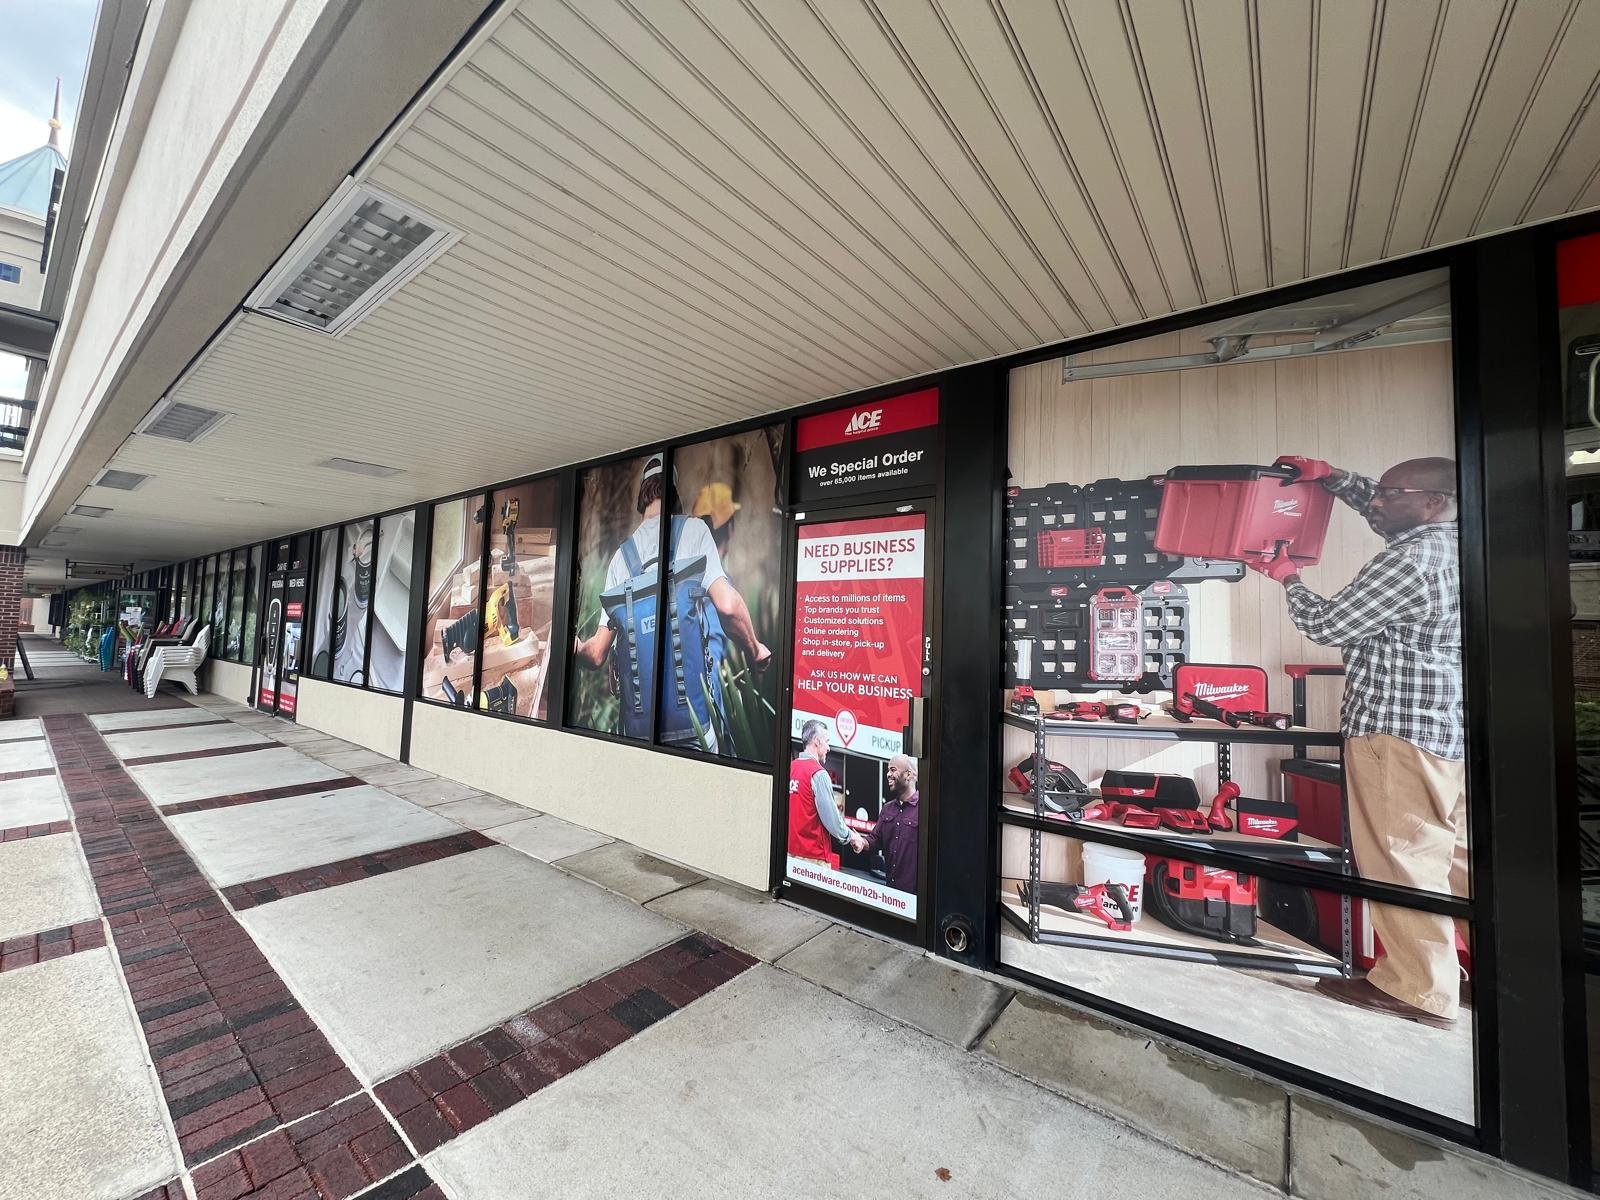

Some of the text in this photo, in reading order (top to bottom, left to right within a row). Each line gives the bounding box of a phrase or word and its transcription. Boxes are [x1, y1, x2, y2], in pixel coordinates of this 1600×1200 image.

[845, 409, 883, 432] ACE
[808, 449, 924, 479] We Special Order
[834, 475, 857, 485] 65,000
[857, 473, 876, 482] items
[877, 467, 909, 479] available
[804, 538, 916, 559] NEED BUSINESS
[820, 557, 894, 574] SUPPLIES?
[804, 593, 906, 603] Access to millions of items
[804, 605, 880, 616] Top brands you trust
[804, 616, 884, 625] Customized solutions
[803, 627, 859, 638] Online ordering
[802, 638, 885, 649] Shop in-store, pick-up
[801, 649, 845, 659] and delivery
[810, 670, 898, 684] ASK US HOW WE CAN
[797, 679, 914, 700] HELP YOUR BUSINESS
[1193, 681, 1250, 697] Milwaukee
[871, 736, 902, 752] PICKUP
[792, 865, 906, 910] acehardware.com/b2b-home
